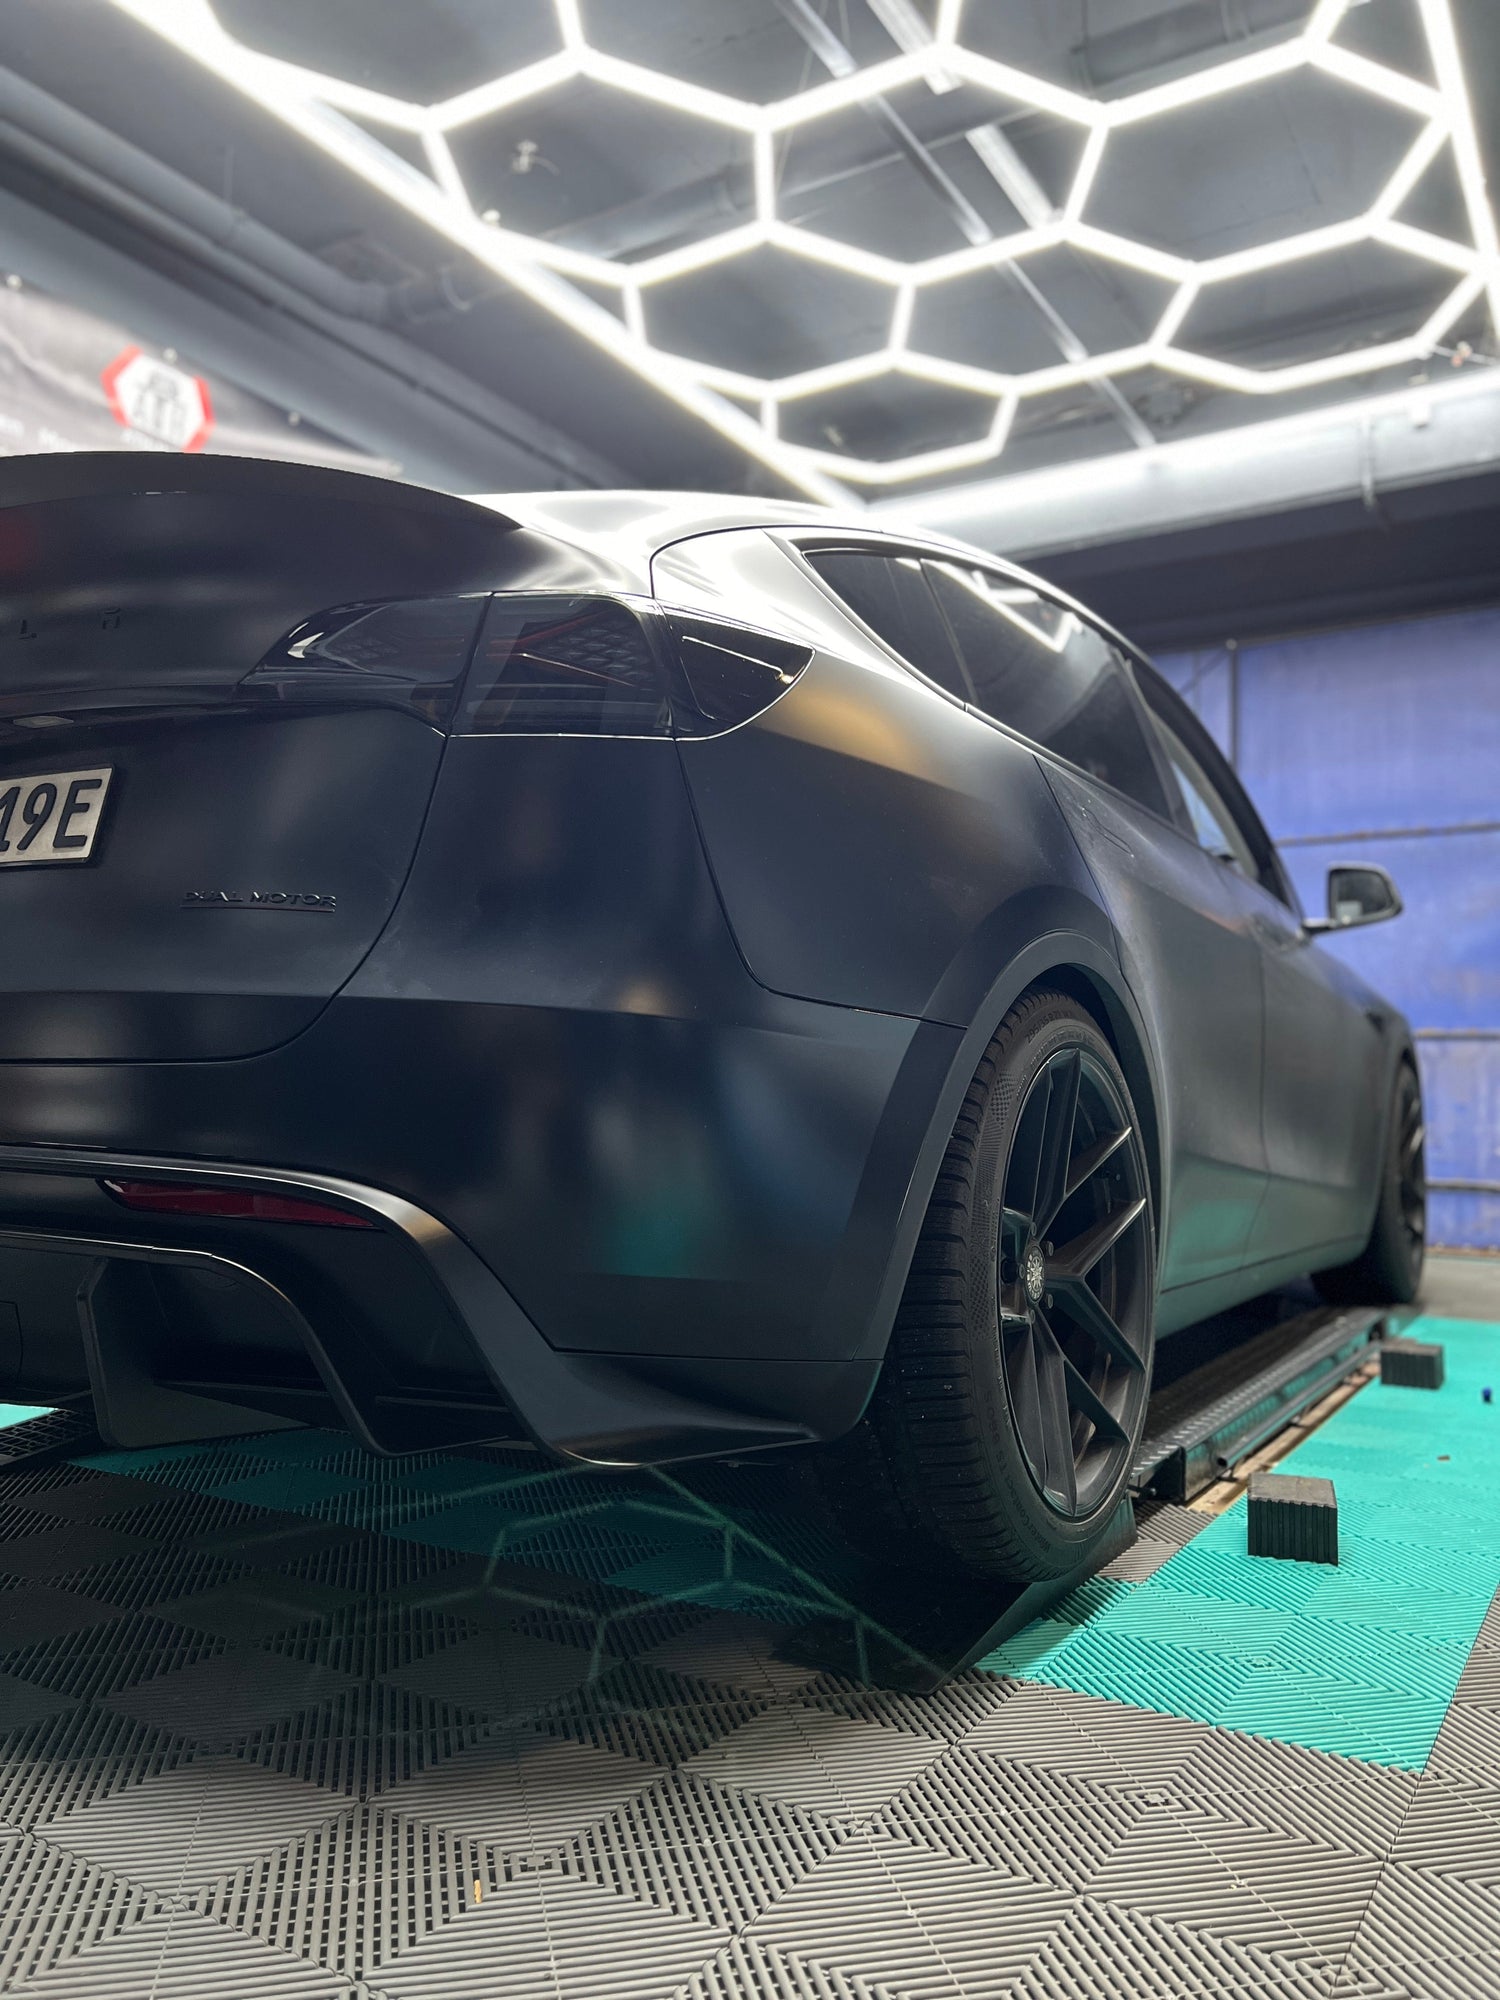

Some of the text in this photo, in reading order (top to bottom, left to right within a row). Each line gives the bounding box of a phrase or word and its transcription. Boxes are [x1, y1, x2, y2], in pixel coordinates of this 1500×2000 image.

[0, 778, 103, 852] 19E
[184, 891, 337, 908] DUAL MOTOR
